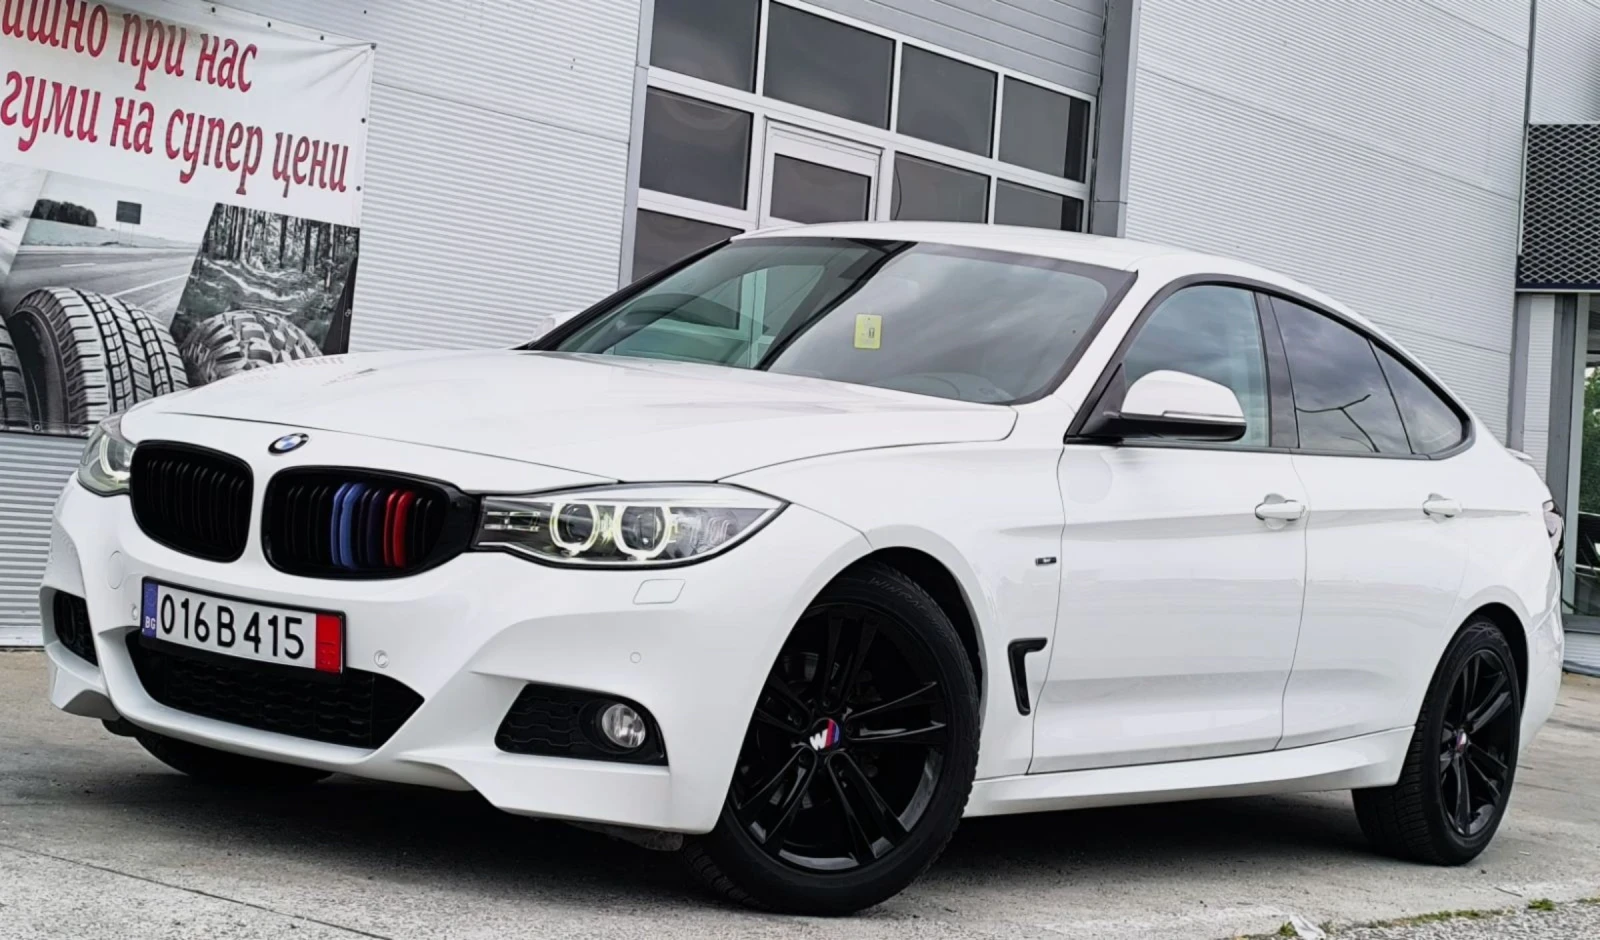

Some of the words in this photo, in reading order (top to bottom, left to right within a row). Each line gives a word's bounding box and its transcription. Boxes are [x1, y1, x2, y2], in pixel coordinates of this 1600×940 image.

[117, 12, 189, 92] при
[195, 33, 258, 93] нас
[0, 70, 102, 152] гуми
[110, 96, 156, 155] на
[164, 107, 264, 196] супер
[271, 131, 349, 199] цени
[145, 615, 156, 630] BG
